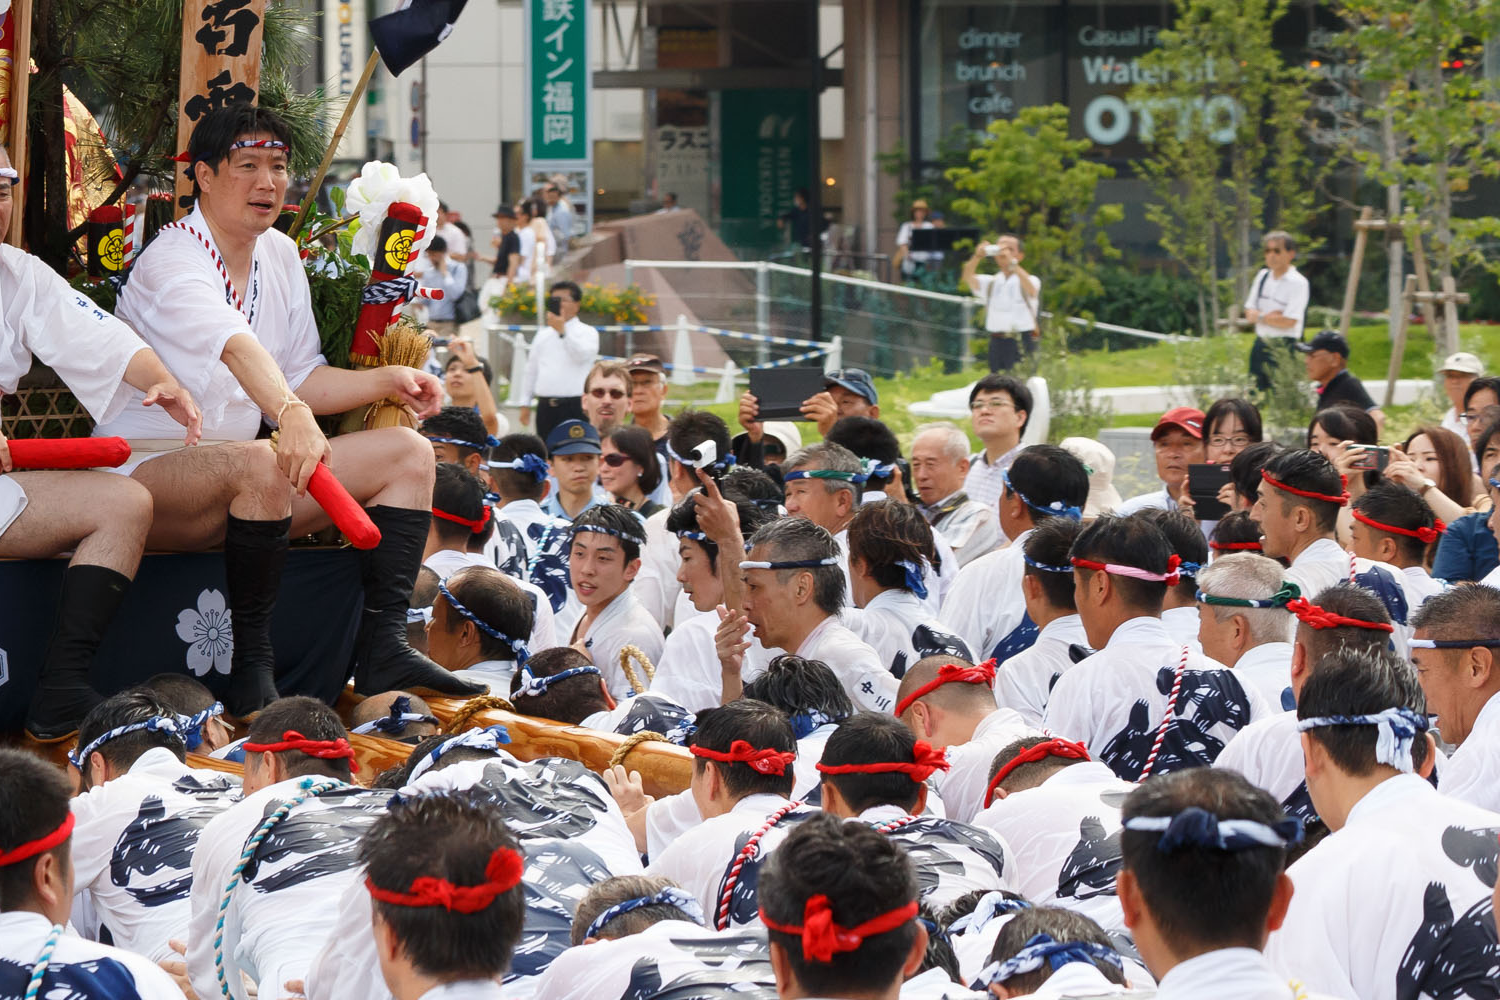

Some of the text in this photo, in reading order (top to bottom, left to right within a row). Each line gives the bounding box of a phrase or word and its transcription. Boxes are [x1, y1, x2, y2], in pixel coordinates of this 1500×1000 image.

[958, 28, 1023, 48] dinner
[1078, 25, 1140, 46] Casual
[956, 60, 1026, 81] brunch
[969, 92, 1014, 113] cafe
[861, 681, 891, 711] 中三
